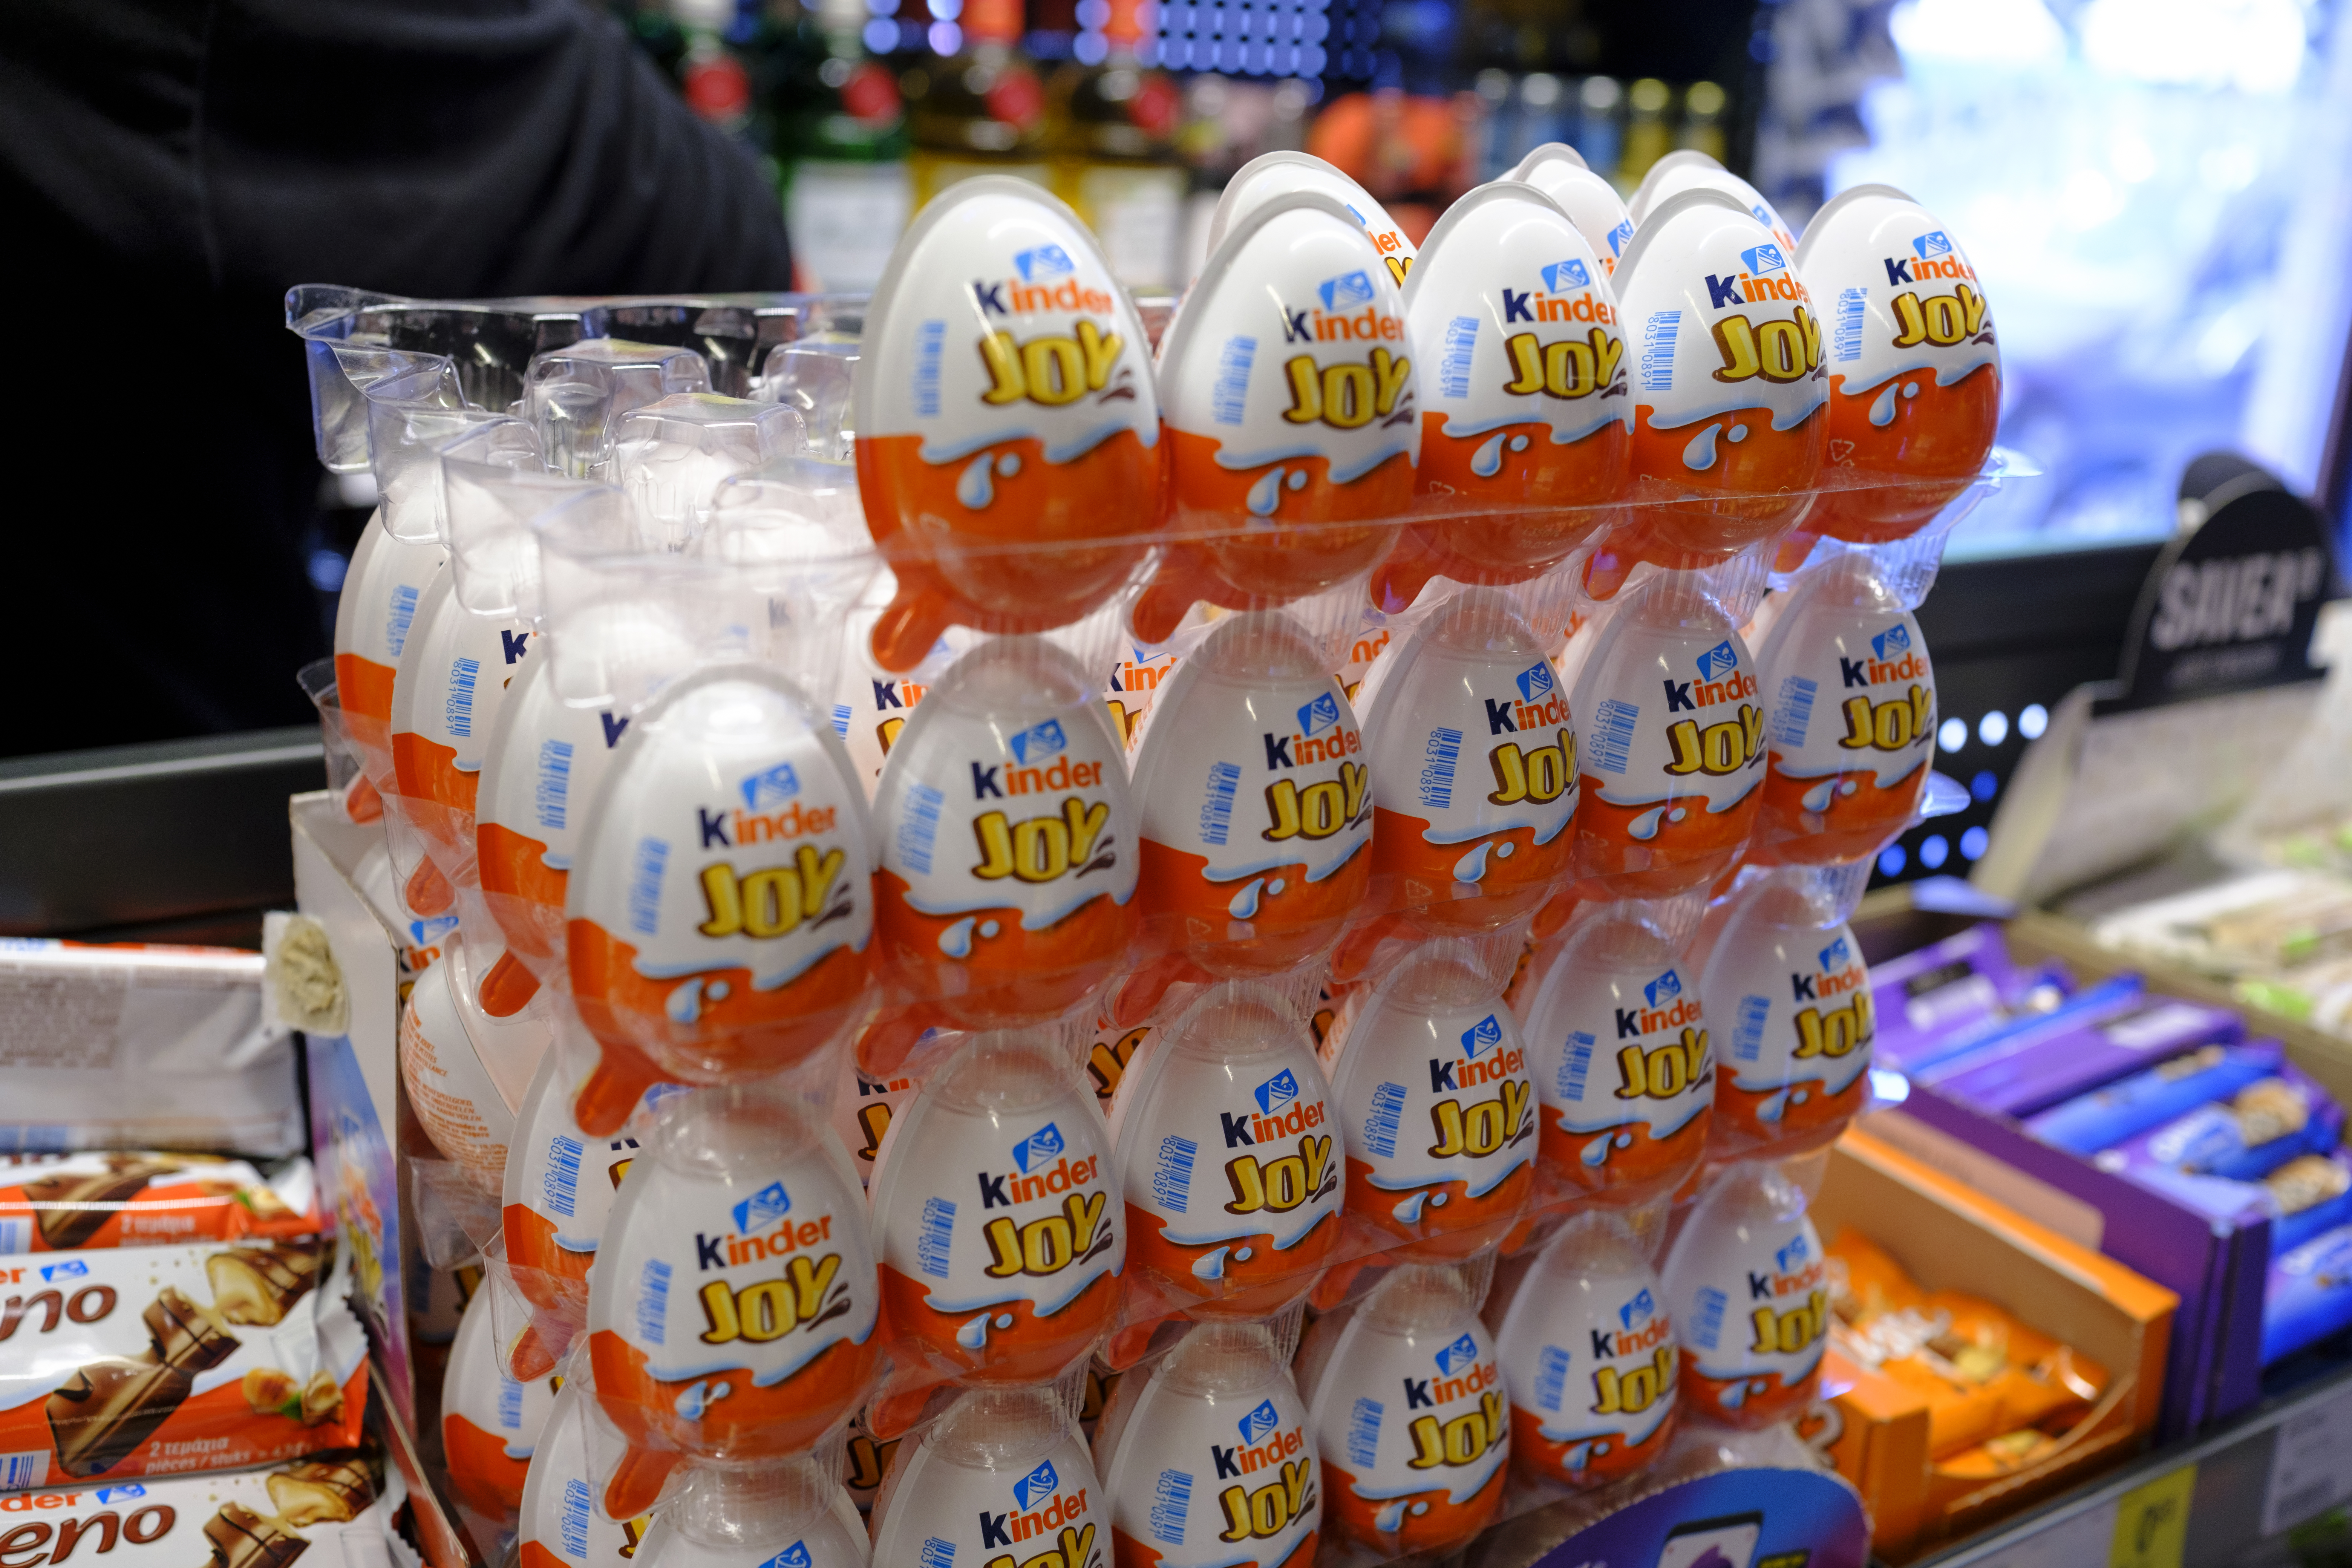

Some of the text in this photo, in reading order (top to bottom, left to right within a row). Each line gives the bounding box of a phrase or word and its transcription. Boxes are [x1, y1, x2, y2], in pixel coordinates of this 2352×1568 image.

[1502, 288, 1616, 326] kinder
[1891, 283, 1986, 349] JOY
[977, 319, 1125, 406] JOY
[1503, 327, 1623, 400] JOY
[1712, 305, 1821, 384] JOY
[1282, 347, 1410, 430] JOY
[1663, 704, 1764, 776] JOY
[1838, 683, 1933, 752] JOY
[971, 757, 1102, 800] kinder
[1262, 761, 1368, 842] JOY
[1487, 727, 1577, 806] JOY
[697, 802, 838, 849] kinder
[971, 796, 1109, 884] JOY
[697, 844, 846, 940] JOY
[1791, 991, 1873, 1059] JOY
[1429, 1047, 1525, 1093] kinder
[1614, 1027, 1709, 1100] JOY
[1220, 1100, 1325, 1148] kinder
[1428, 1079, 1530, 1159] JOY
[978, 1153, 1098, 1209] kinder
[1224, 1134, 1333, 1215] JOY
[697, 1214, 832, 1271] kinder
[982, 1191, 1106, 1278] JOY
[698, 1253, 842, 1346] JOY
[1589, 1344, 1676, 1415] JOY
[1211, 1426, 1303, 1480] kinder
[1406, 1390, 1503, 1470] JOY
[979, 1487, 1088, 1550] kinder
[1218, 1458, 1310, 1543] JOY
